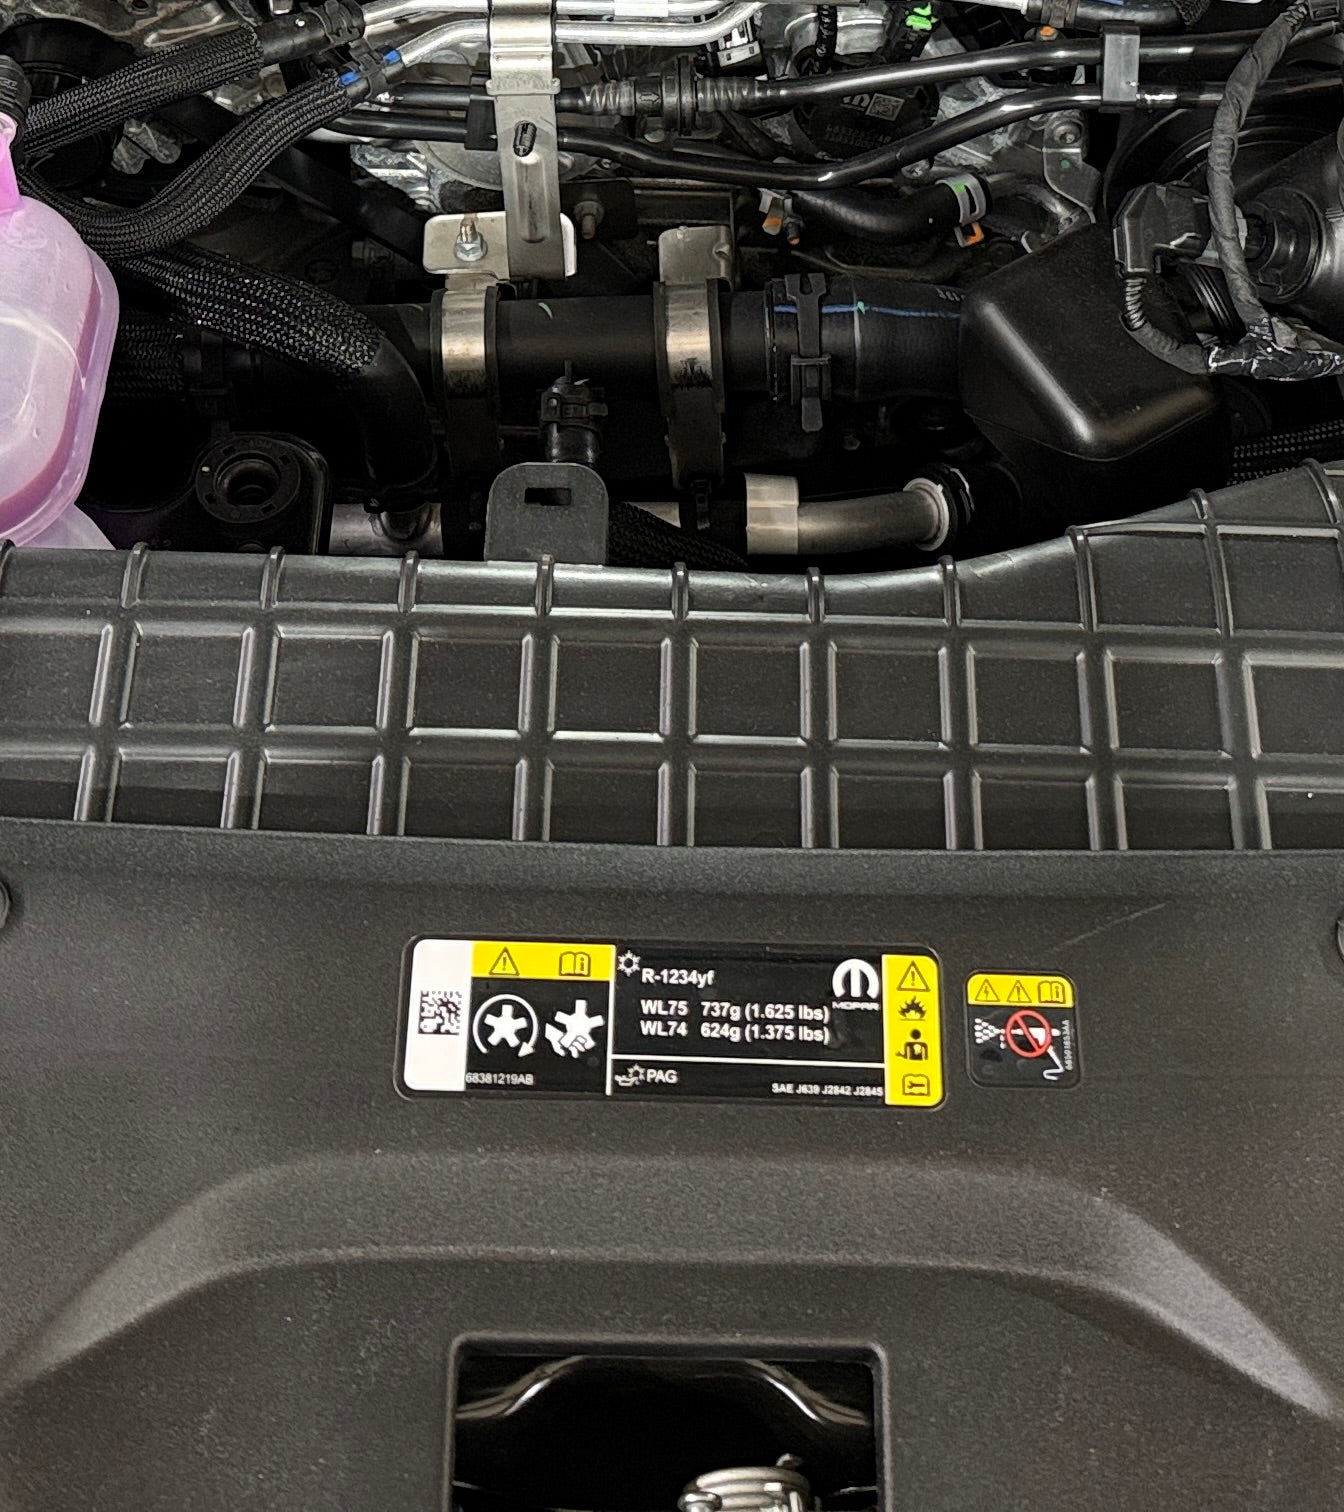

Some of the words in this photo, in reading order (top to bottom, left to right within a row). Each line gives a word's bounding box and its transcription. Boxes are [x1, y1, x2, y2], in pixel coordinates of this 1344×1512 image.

[641, 967, 714, 988] R-1234yf
[640, 999, 688, 1016] WL75
[701, 1001, 741, 1022] 737g
[744, 1003, 795, 1022] (1.625
[798, 1004, 830, 1023] lbs)
[832, 1001, 880, 1012] MOPAR
[640, 1020, 688, 1037] WL74
[701, 1022, 741, 1043] 624g
[744, 1023, 795, 1043] (1.375
[798, 1025, 830, 1045] lbs)
[646, 1069, 678, 1084] PAG
[771, 1083, 794, 1094] SAE
